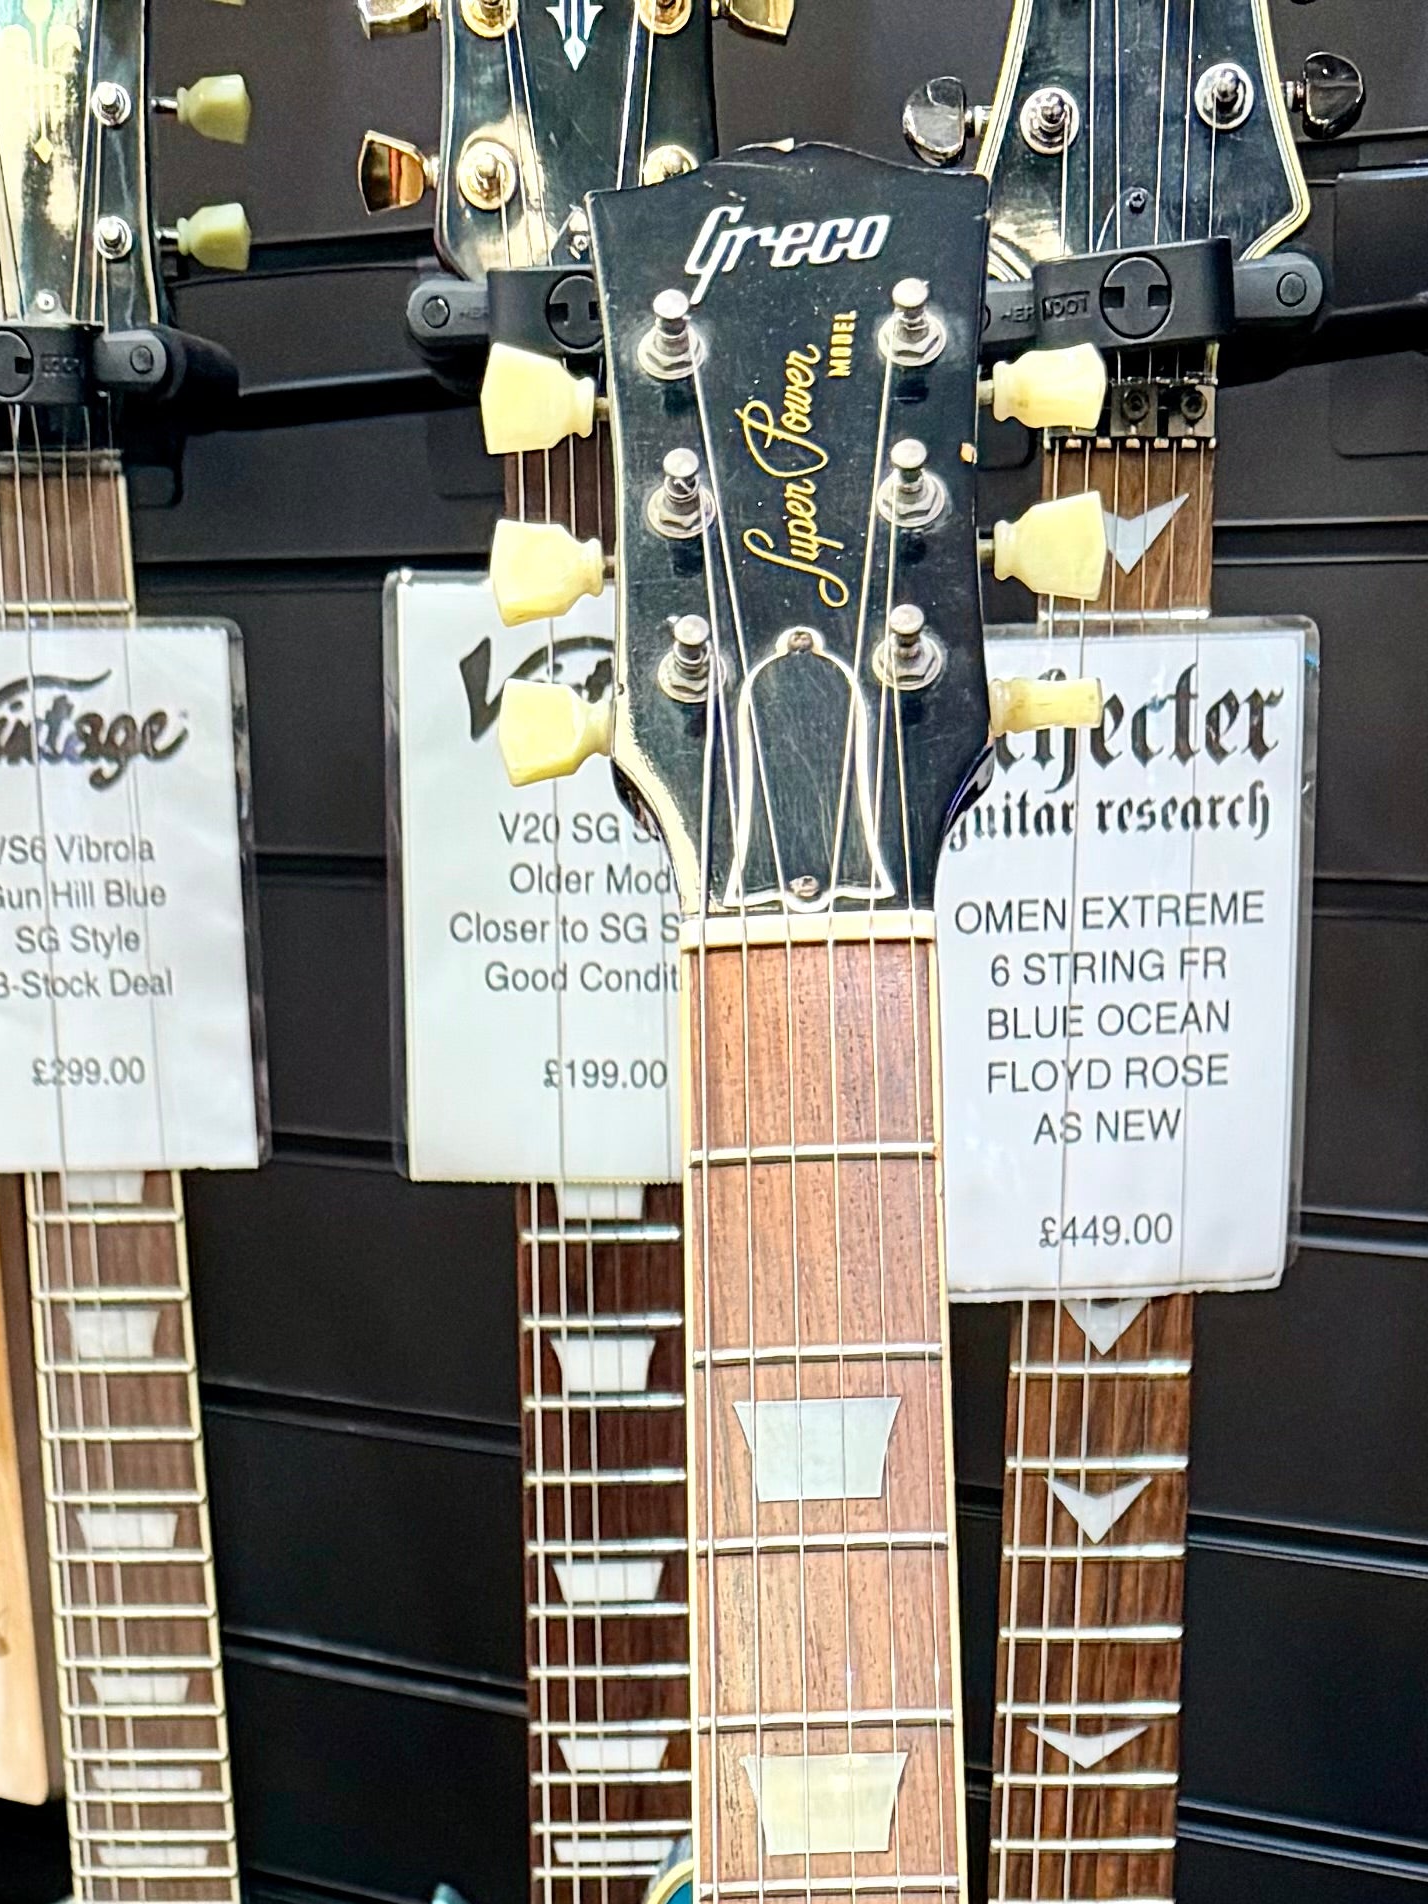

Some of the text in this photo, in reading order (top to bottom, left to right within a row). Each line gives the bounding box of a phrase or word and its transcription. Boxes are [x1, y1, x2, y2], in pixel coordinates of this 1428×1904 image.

[685, 206, 890, 305] Greco
[827, 309, 857, 378] MODEL
[735, 344, 850, 608] Super Power
[990, 664, 1285, 794] checter
[499, 813, 559, 843] V20
[573, 813, 620, 843] SG
[950, 779, 1271, 852] guitar research
[57, 835, 155, 863] Vibrola
[50, 880, 96, 908] Hill
[105, 879, 167, 908] Blue
[509, 863, 594, 895] Older
[450, 911, 651, 944] Closer to SG
[955, 891, 1266, 935] OMEN EXTREME
[14, 925, 141, 960] SG Style
[109, 968, 174, 998] Deal
[485, 961, 681, 994] Good Condit
[990, 947, 1227, 986] 6 STRING FR
[988, 1000, 1231, 1041] BLUE OCEAN
[31, 1056, 147, 1087] £299.00
[543, 1058, 668, 1091] £199.00
[987, 1053, 1230, 1094] FLOYD ROSE
[1034, 1107, 1182, 1146] AS NEW
[1040, 1212, 1173, 1248] £449.00
